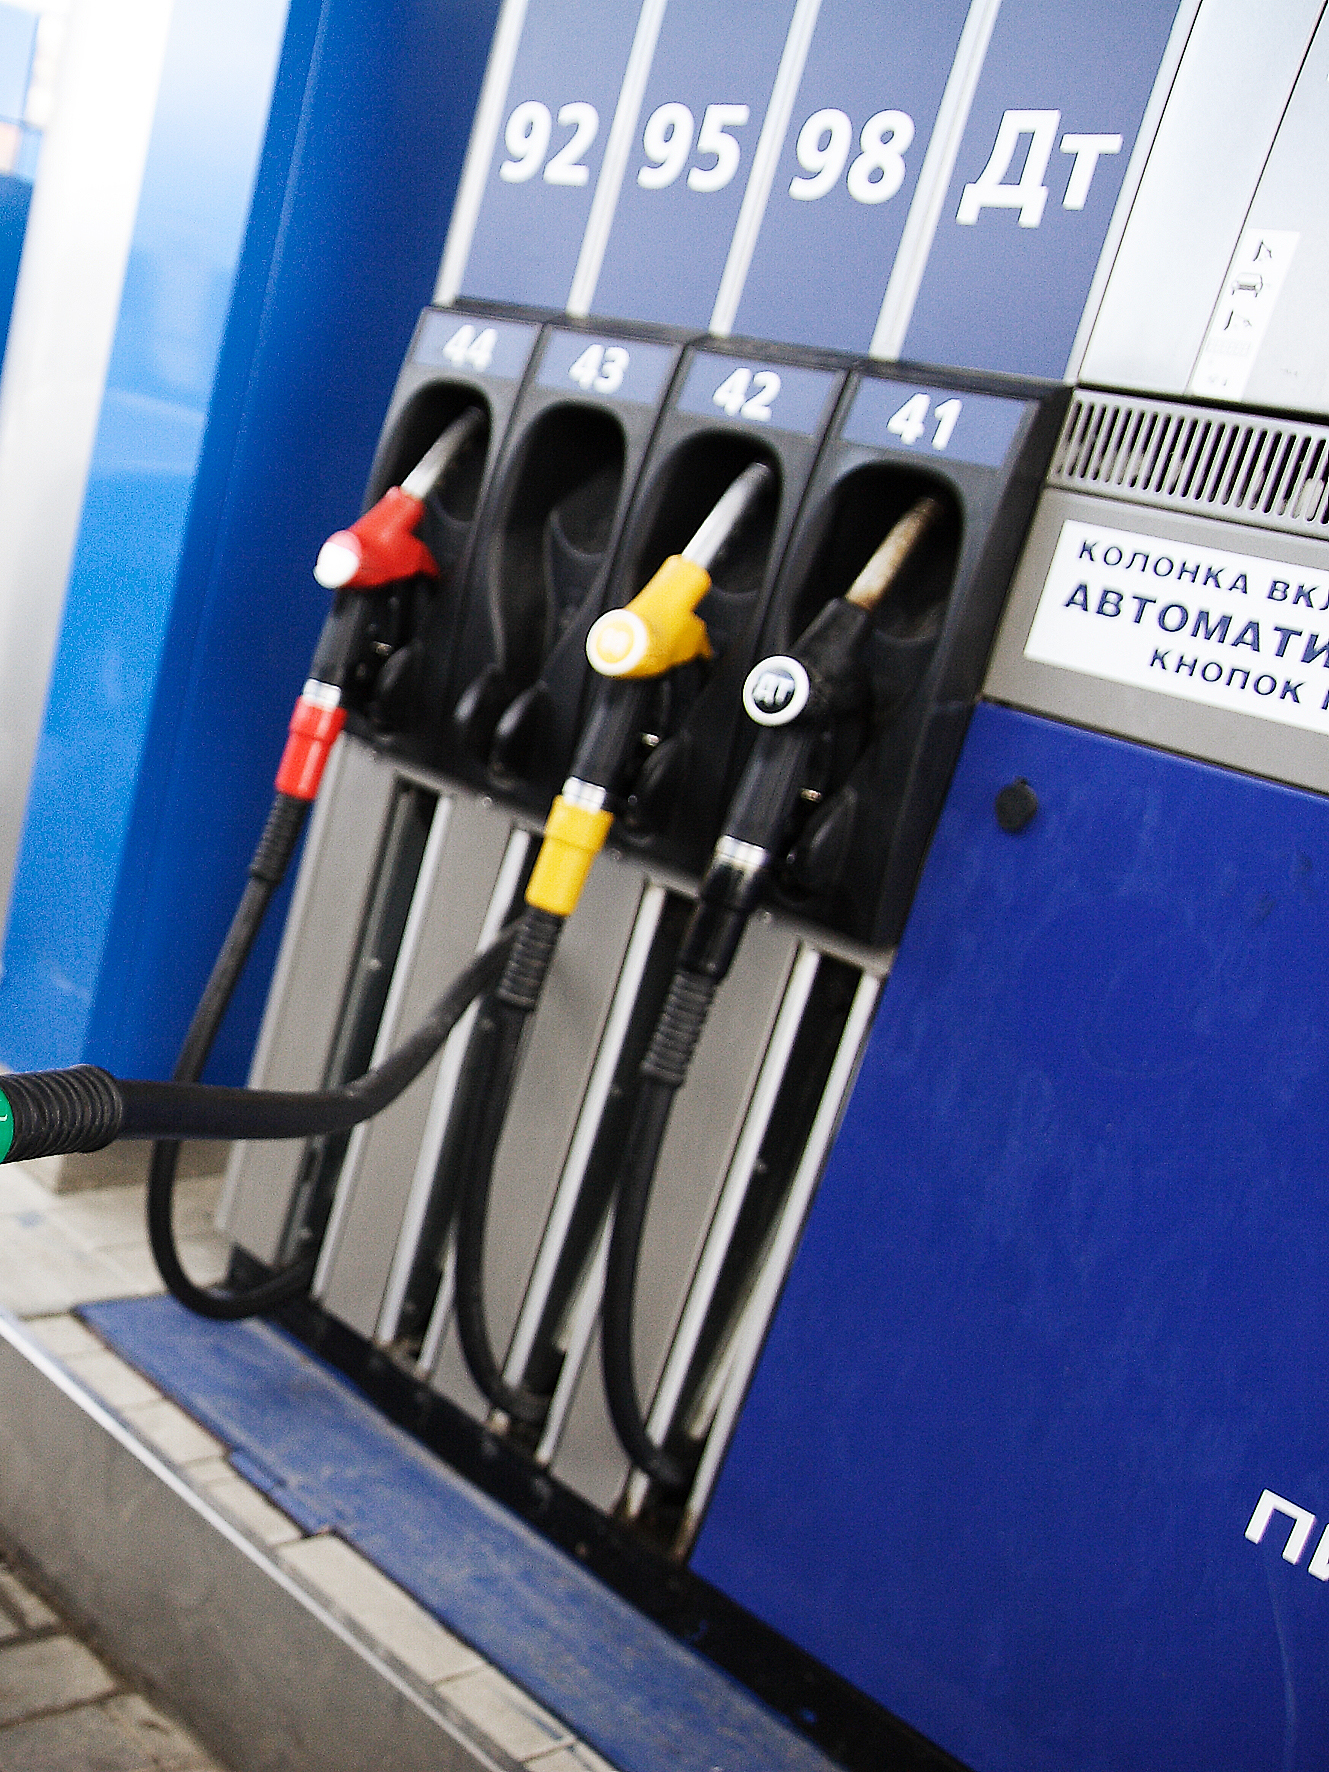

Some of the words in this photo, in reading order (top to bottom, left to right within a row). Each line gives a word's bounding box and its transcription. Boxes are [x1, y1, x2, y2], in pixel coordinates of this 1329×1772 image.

[500, 100, 599, 187] 92
[637, 102, 750, 193] 95
[788, 108, 915, 205] 98
[442, 324, 499, 373] 44
[568, 343, 630, 395] 43
[712, 366, 781, 422] 42
[887, 392, 963, 451] 41
[1078, 539, 1249, 594] КОЛОНКА
[1149, 647, 1307, 704] КНОПОК
